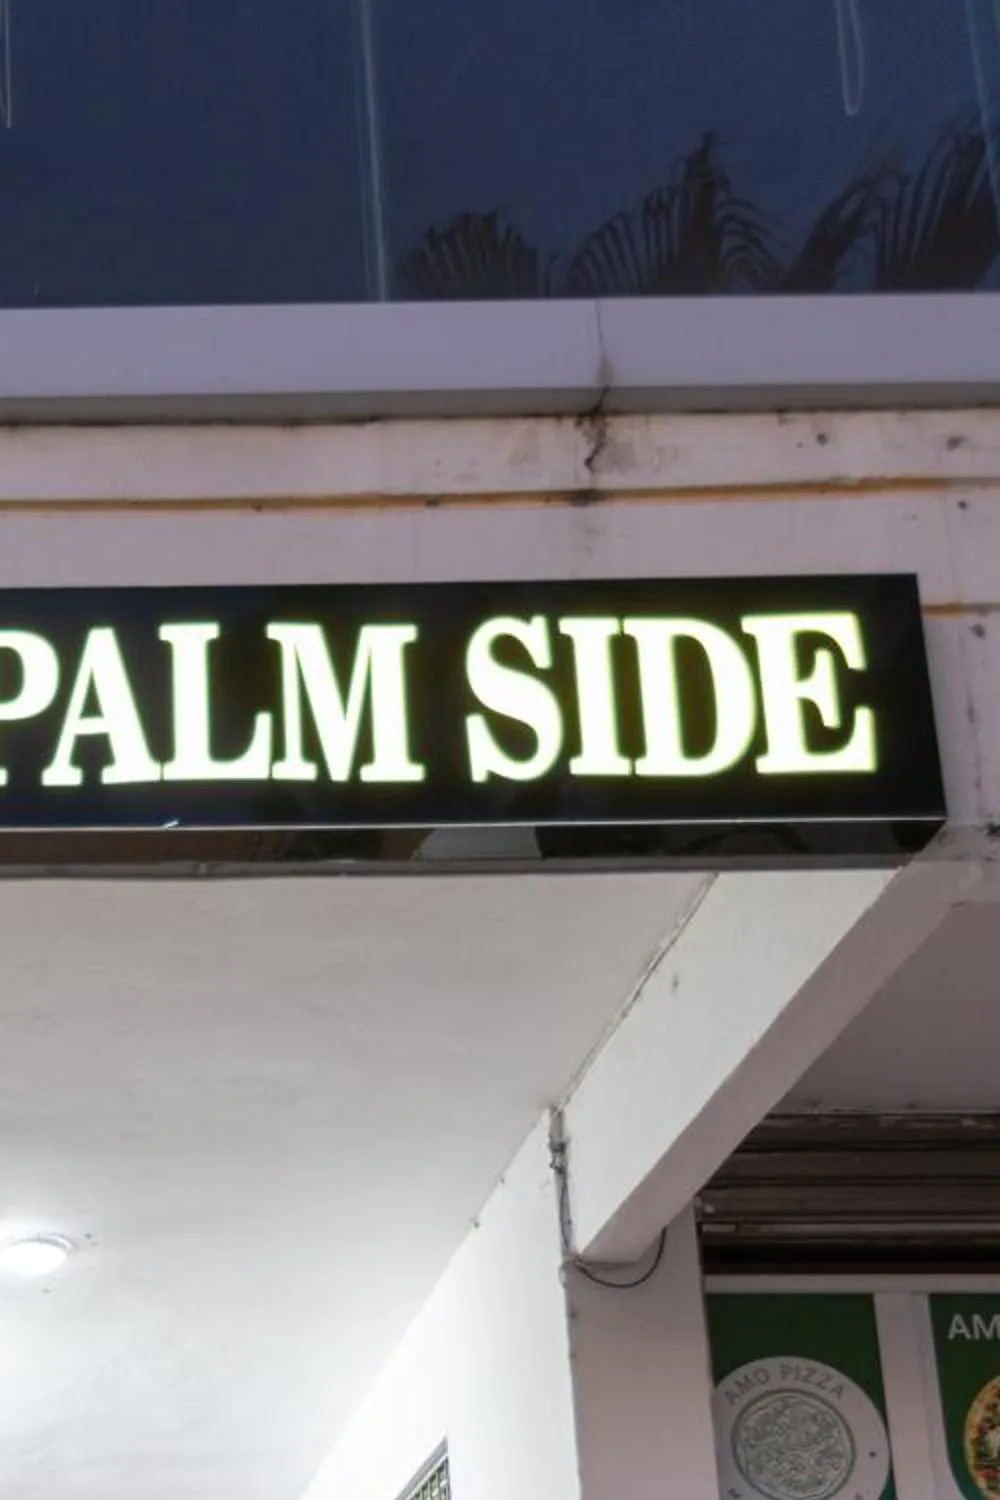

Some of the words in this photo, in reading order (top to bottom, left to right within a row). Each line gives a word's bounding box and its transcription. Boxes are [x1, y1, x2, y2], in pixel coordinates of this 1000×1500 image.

[464, 612, 877, 784] SIDE
[724, 1368, 770, 1406] AMO
[780, 1364, 844, 1399] PIZZA
